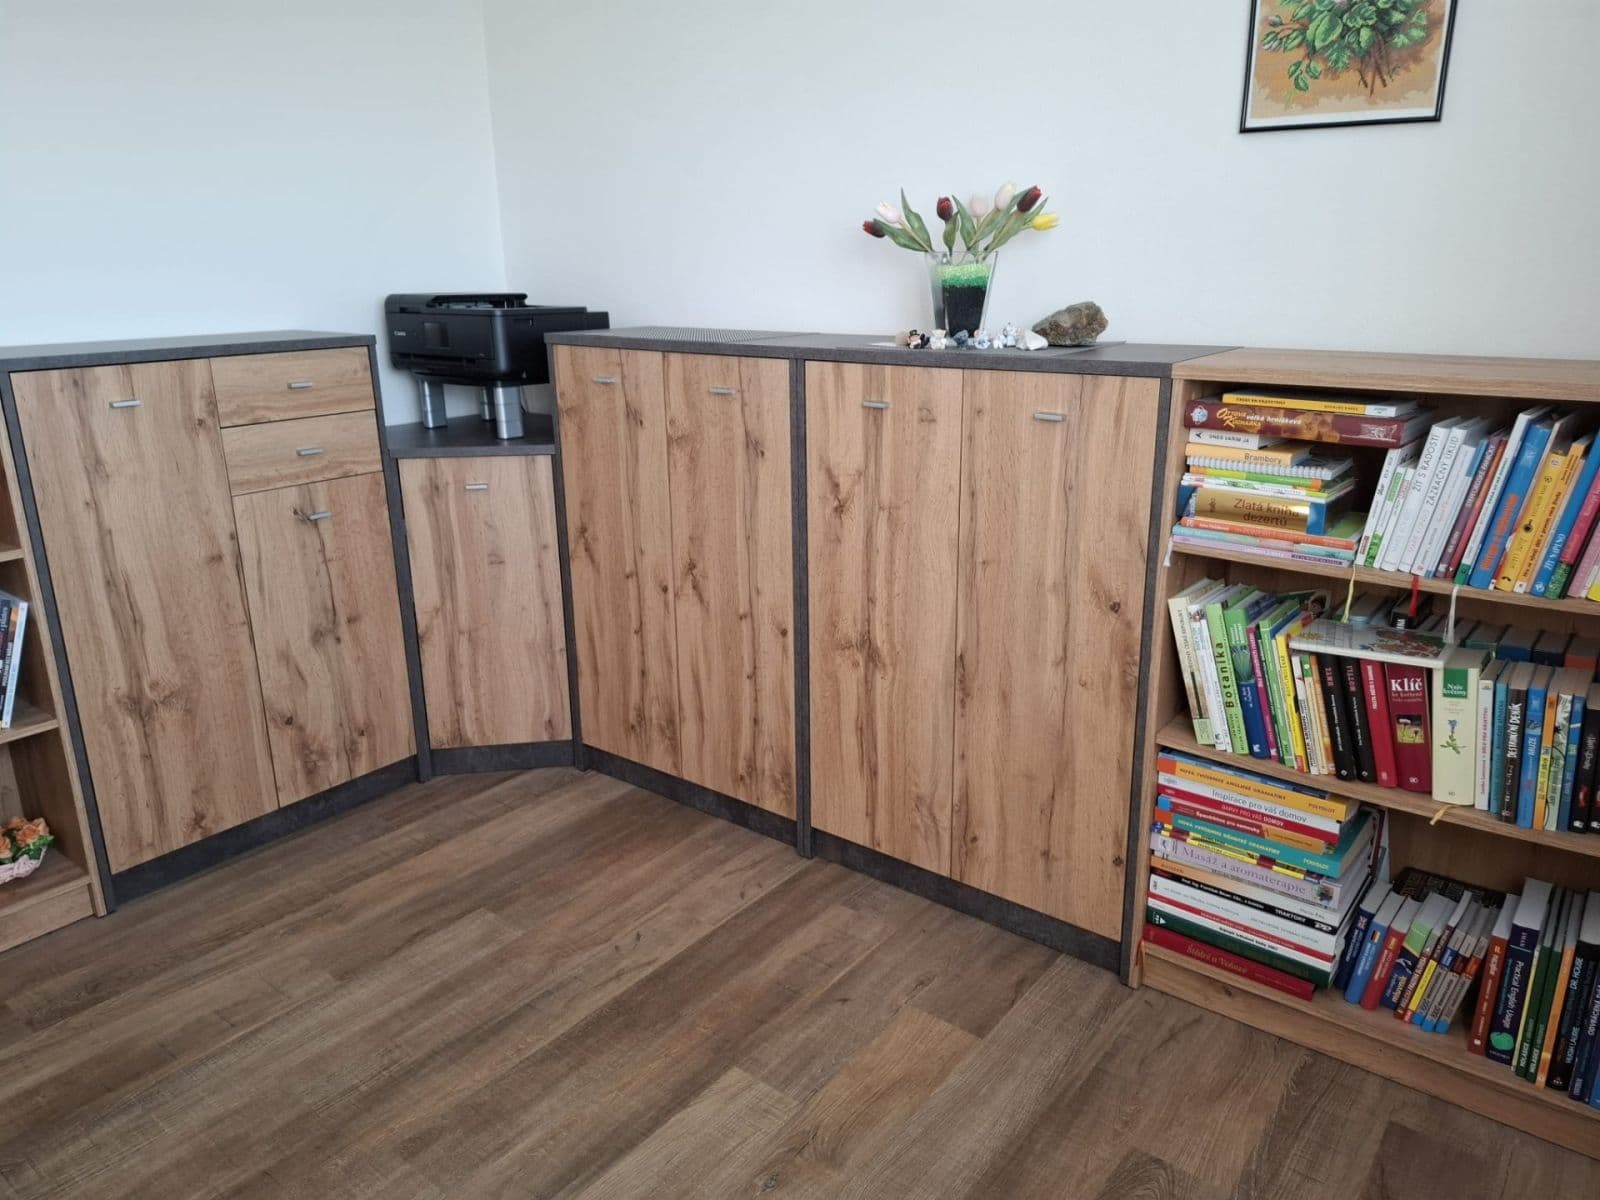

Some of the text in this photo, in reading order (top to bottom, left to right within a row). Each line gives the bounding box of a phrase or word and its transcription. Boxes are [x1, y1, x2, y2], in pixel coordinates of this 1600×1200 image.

[1445, 435, 1460, 461] ÚKLID
[1244, 452, 1283, 465] Brambory
[1233, 497, 1264, 512] Zlatá
[1242, 511, 1288, 526] dezertů
[1215, 641, 1235, 709] Botanika
[1390, 677, 1423, 692] Klíč
[1252, 787, 1286, 801] GRAMATIKY
[1211, 788, 1308, 823] Inspirace pro váš domov
[1263, 815, 1284, 827] DOMOV
[1181, 845, 1307, 895] Masáž a aromaterapie
[1274, 908, 1307, 924] TRAKTORY
[1500, 959, 1525, 1029] Practical English Usage
